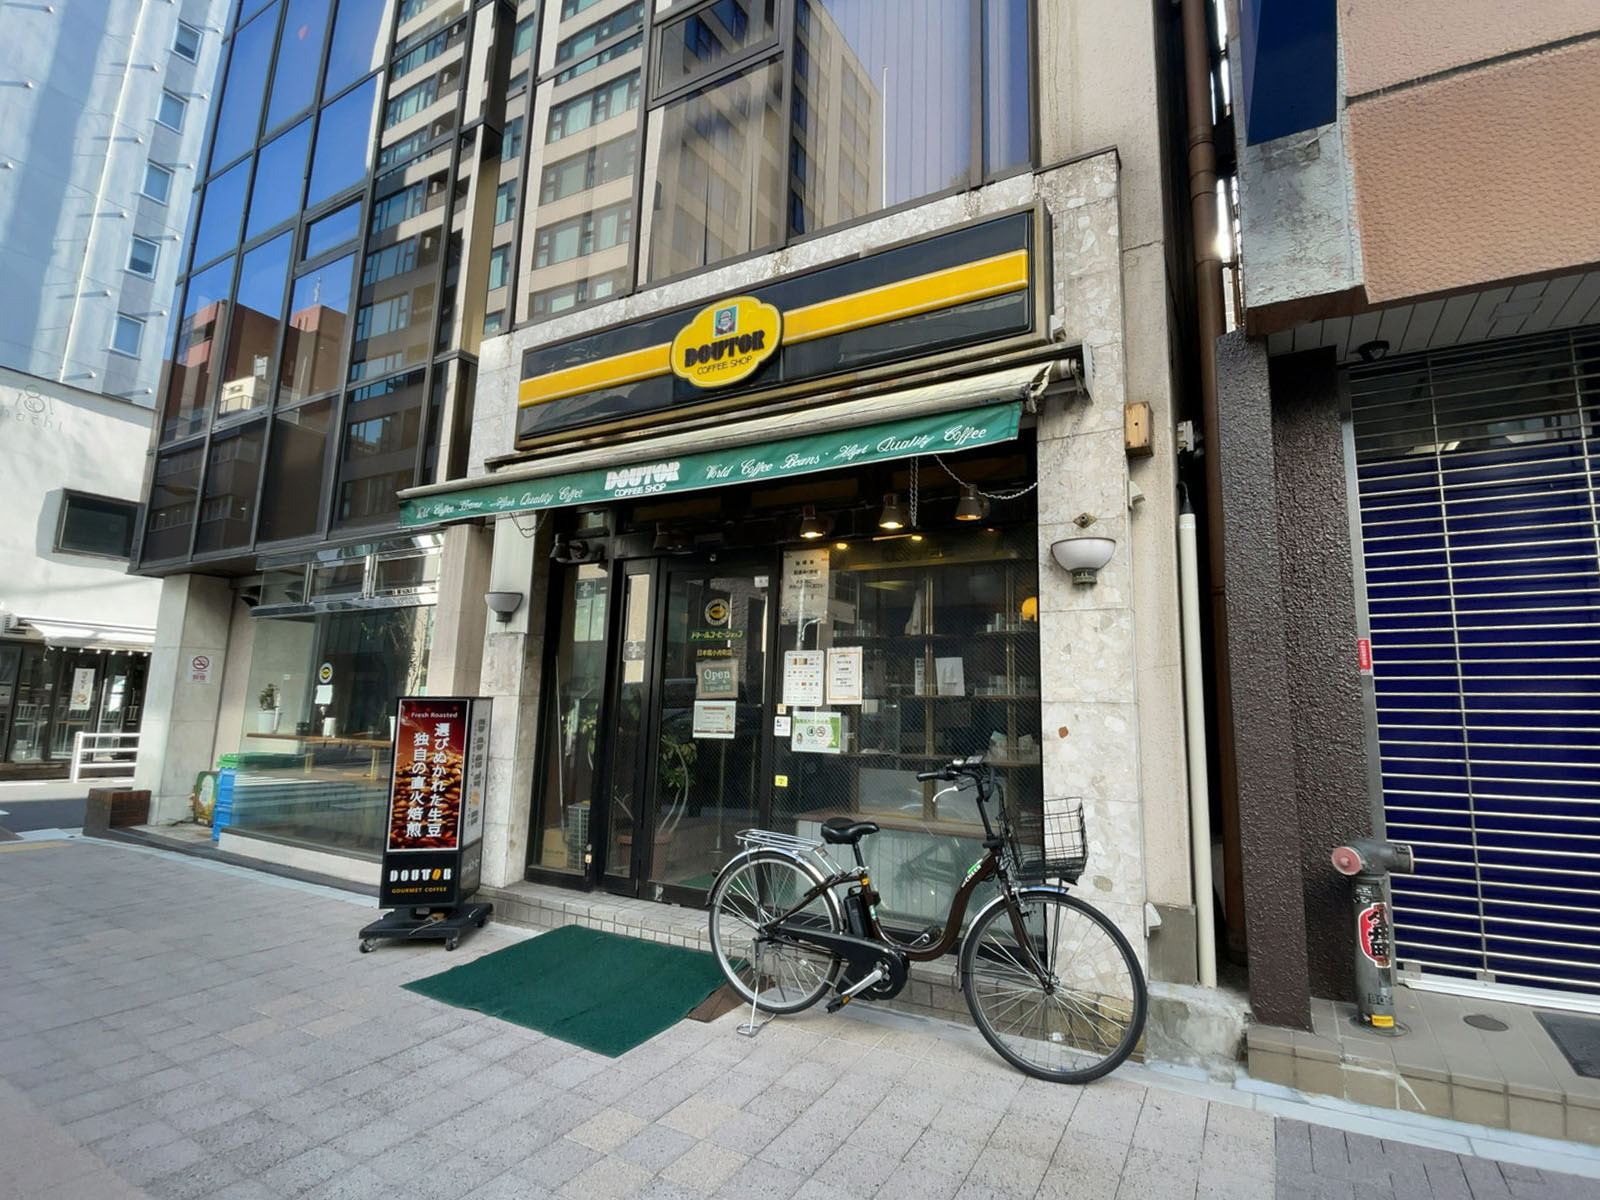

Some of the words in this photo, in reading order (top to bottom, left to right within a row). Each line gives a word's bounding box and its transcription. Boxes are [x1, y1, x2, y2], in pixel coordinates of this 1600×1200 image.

[684, 329, 765, 368] DOUTOR
[697, 361, 729, 375] COFFEE
[730, 355, 752, 368] SHOP
[740, 458, 773, 478] Coffee
[780, 452, 820, 469] Beans
[876, 435, 934, 453] Quality
[943, 424, 987, 446] Coffee
[604, 461, 680, 491] DOUTOR
[558, 486, 584, 503] Coffee
[614, 486, 643, 497] COFFEE
[645, 482, 667, 494] SHOP
[704, 668, 730, 681] Open
[406, 732, 430, 838] 独自の直火焙煎
[426, 722, 450, 838] 選びぬかれた生豆
[389, 868, 452, 882] DOUTOR
